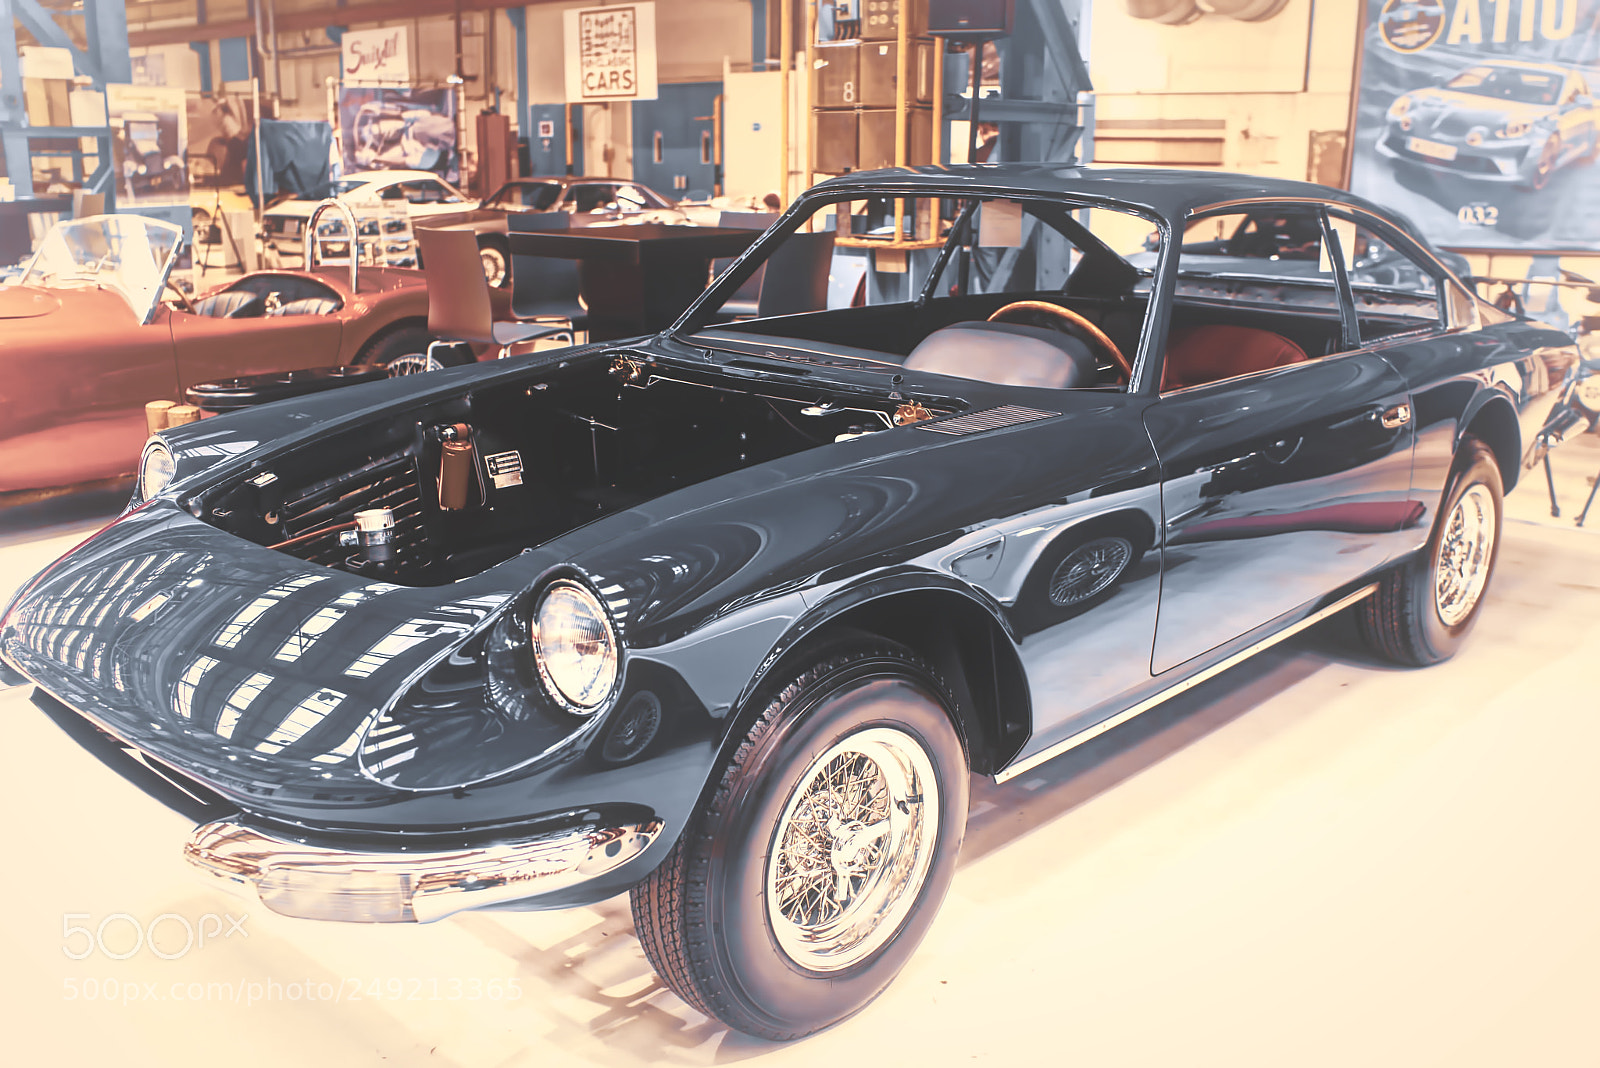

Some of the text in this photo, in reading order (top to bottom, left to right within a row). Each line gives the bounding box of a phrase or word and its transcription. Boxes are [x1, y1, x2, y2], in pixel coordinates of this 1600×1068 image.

[1446, 0, 1577, 44] A110
[585, 69, 632, 91] CARS
[843, 81, 854, 102] 8
[1458, 206, 1498, 225] 032
